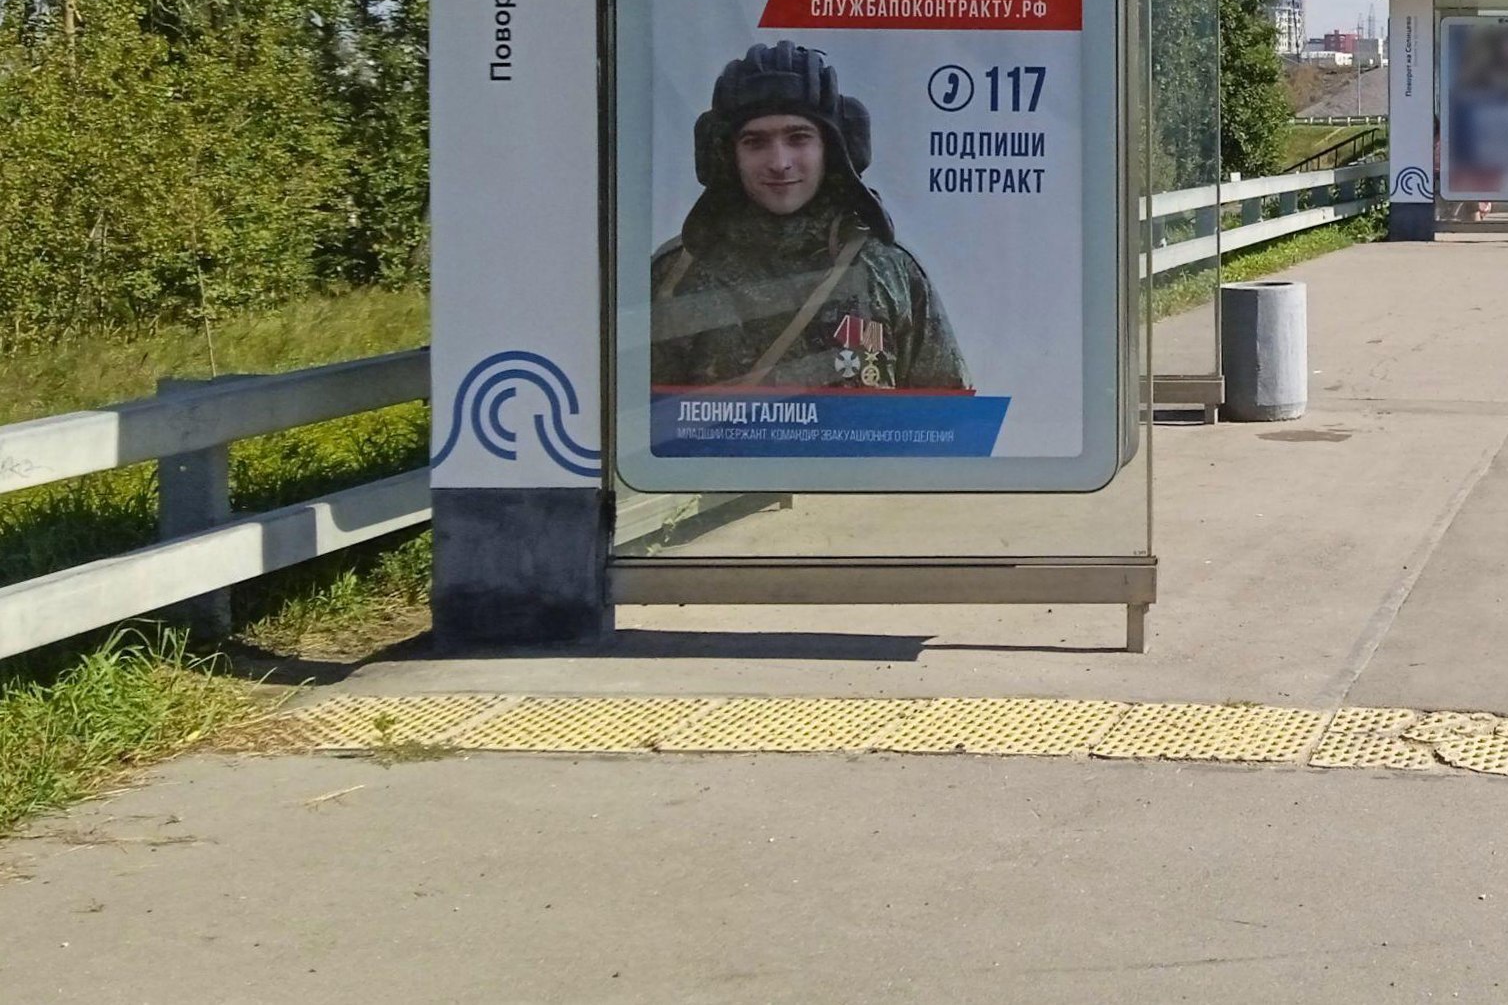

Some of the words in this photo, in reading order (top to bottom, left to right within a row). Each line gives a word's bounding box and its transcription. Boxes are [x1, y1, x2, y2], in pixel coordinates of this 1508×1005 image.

[985, 66, 1047, 112] 117
[929, 132, 1045, 159] ПОДПИШИ
[929, 168, 1045, 194] КОНТРАКТ
[678, 401, 747, 424] ЛЕОНИД
[751, 402, 818, 425] ГАЛИЦА
